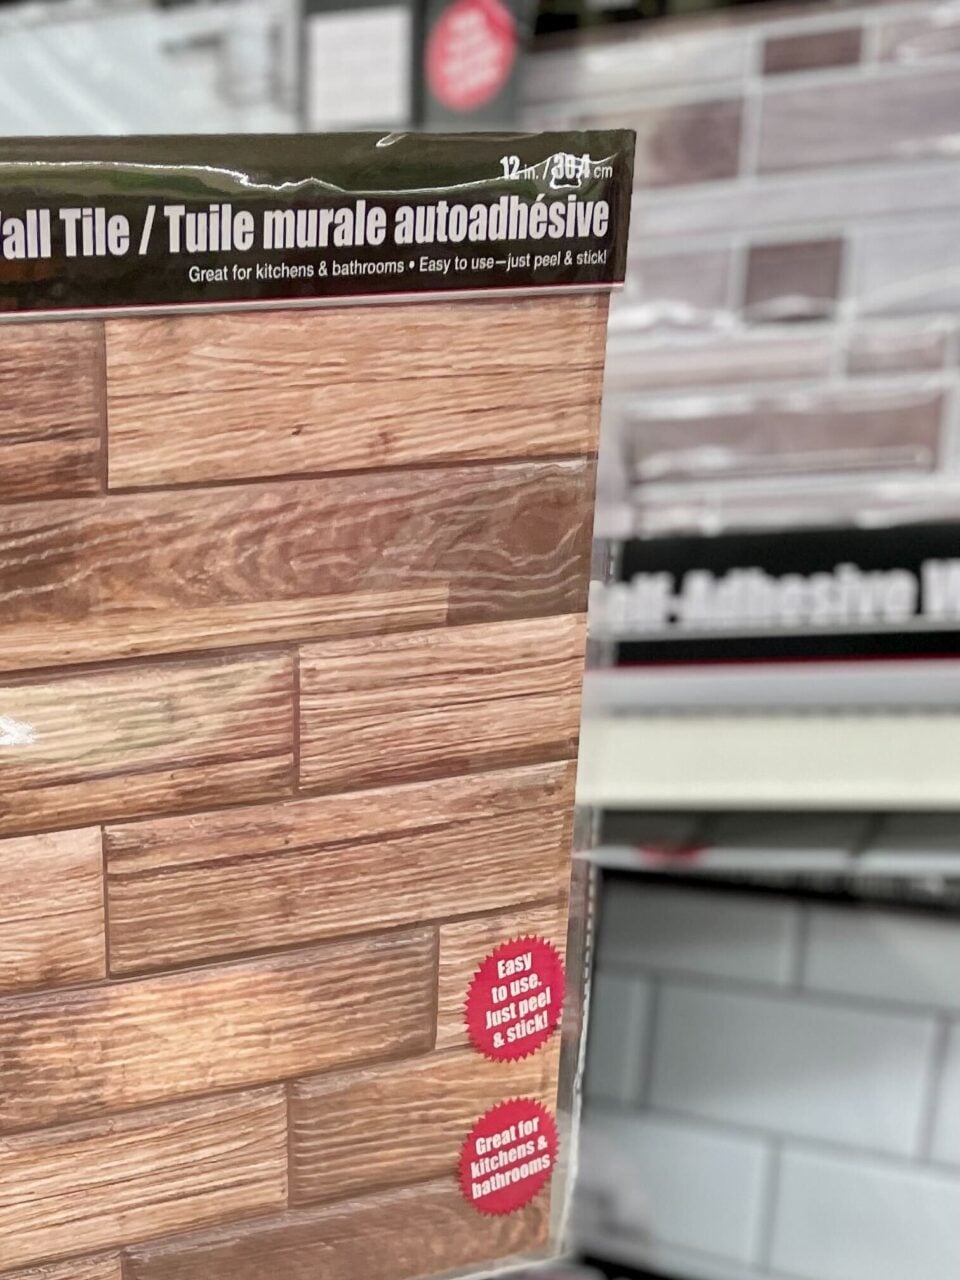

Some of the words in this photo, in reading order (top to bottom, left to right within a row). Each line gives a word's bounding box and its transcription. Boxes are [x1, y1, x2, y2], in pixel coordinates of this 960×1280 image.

[500, 155, 520, 180] 12
[593, 165, 613, 179] cm
[59, 207, 131, 257] Tile
[138, 205, 156, 256] /
[163, 203, 255, 253] Tuile
[262, 199, 387, 250] murale
[393, 194, 610, 244] autoadhésive
[188, 265, 229, 283] Great
[233, 263, 253, 281] for
[256, 261, 315, 280] kitchens
[318, 260, 329, 277] &
[332, 257, 405, 276] bathrooms
[419, 256, 451, 274] Easy
[455, 256, 468, 271] to
[534, 250, 561, 270] peel
[563, 249, 574, 266] &
[576, 248, 607, 265] stick!
[497, 951, 532, 979] Easy
[491, 985, 508, 1004] to
[509, 973, 543, 997] use.
[518, 986, 551, 1018] peel
[493, 1031, 505, 1049] &
[506, 1010, 549, 1043] stick!
[475, 1125, 517, 1155] Great
[518, 1116, 540, 1138] for
[470, 1140, 535, 1179] kitchens
[537, 1135, 548, 1151] &
[471, 1153, 551, 1200] bathrooms
